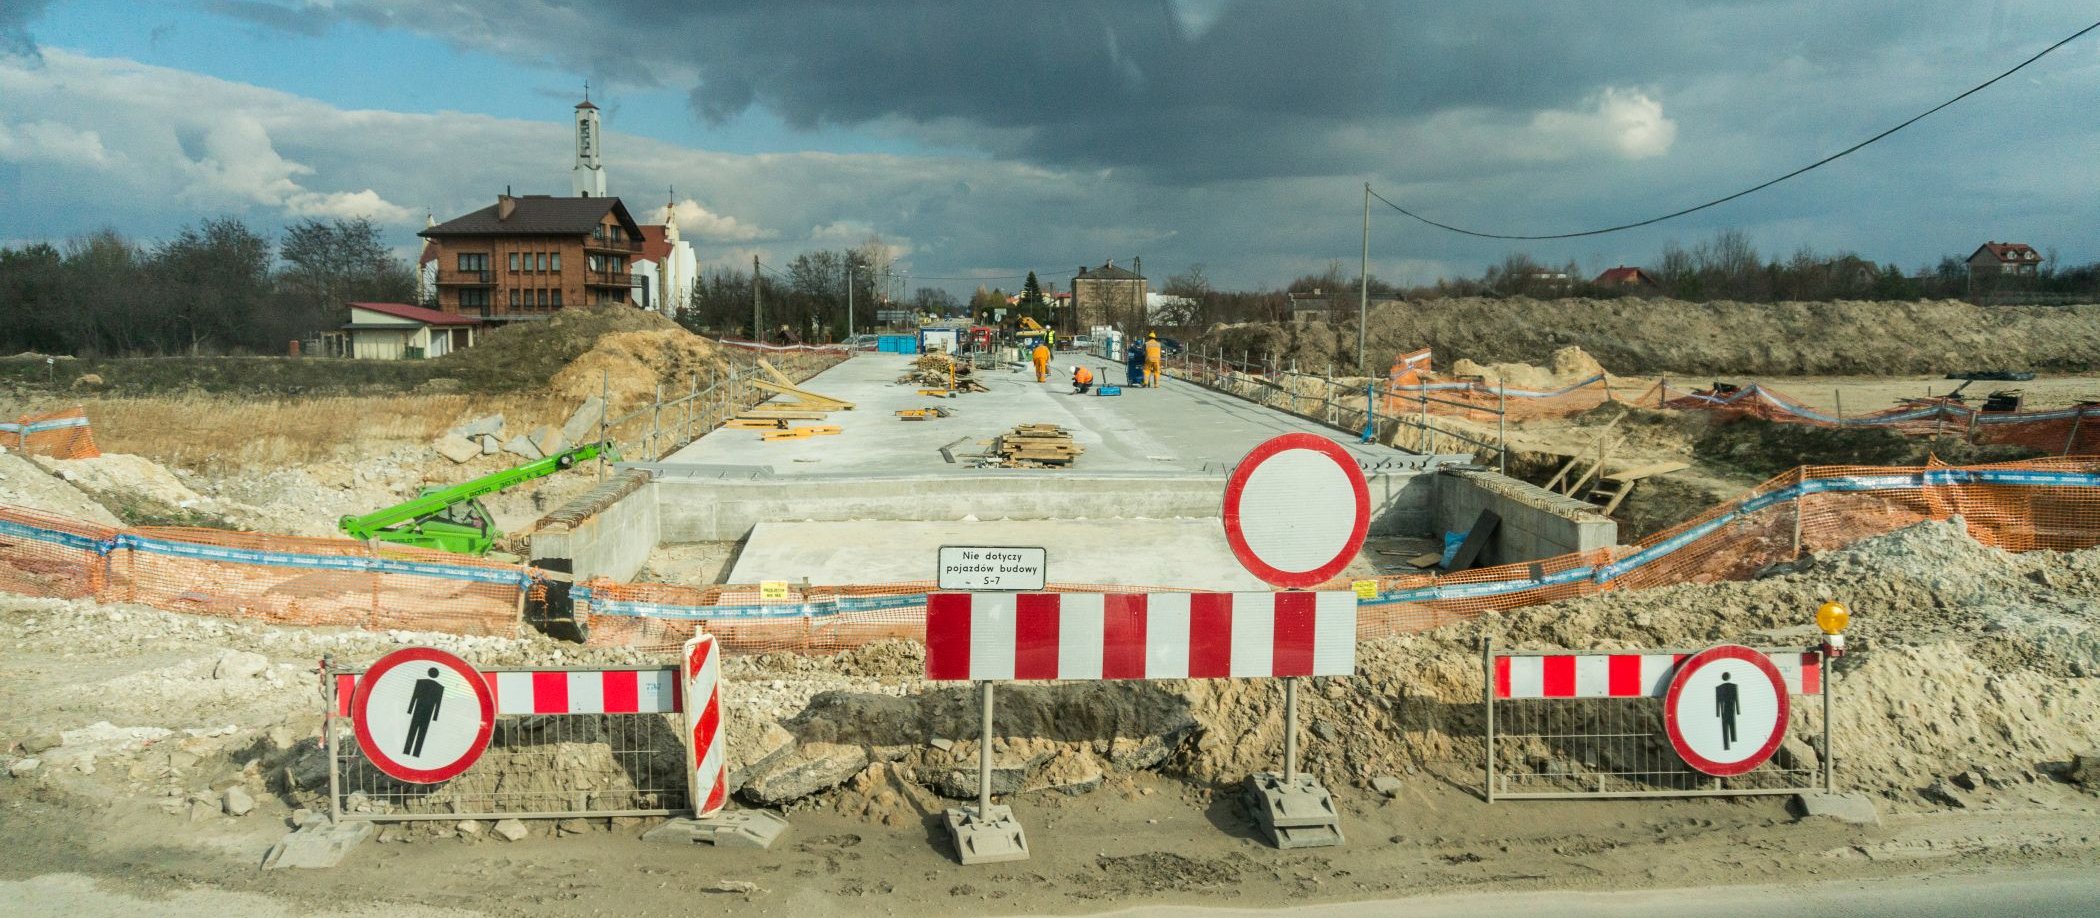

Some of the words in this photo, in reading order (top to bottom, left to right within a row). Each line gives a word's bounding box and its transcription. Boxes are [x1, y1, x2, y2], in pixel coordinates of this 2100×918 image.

[469, 487, 492, 497] ROTO
[962, 551, 979, 560] Nie
[985, 551, 1022, 562] dotyczy
[946, 564, 994, 574] pojazdów
[1000, 565, 1038, 575] budowy
[983, 576, 1001, 585] S-7
